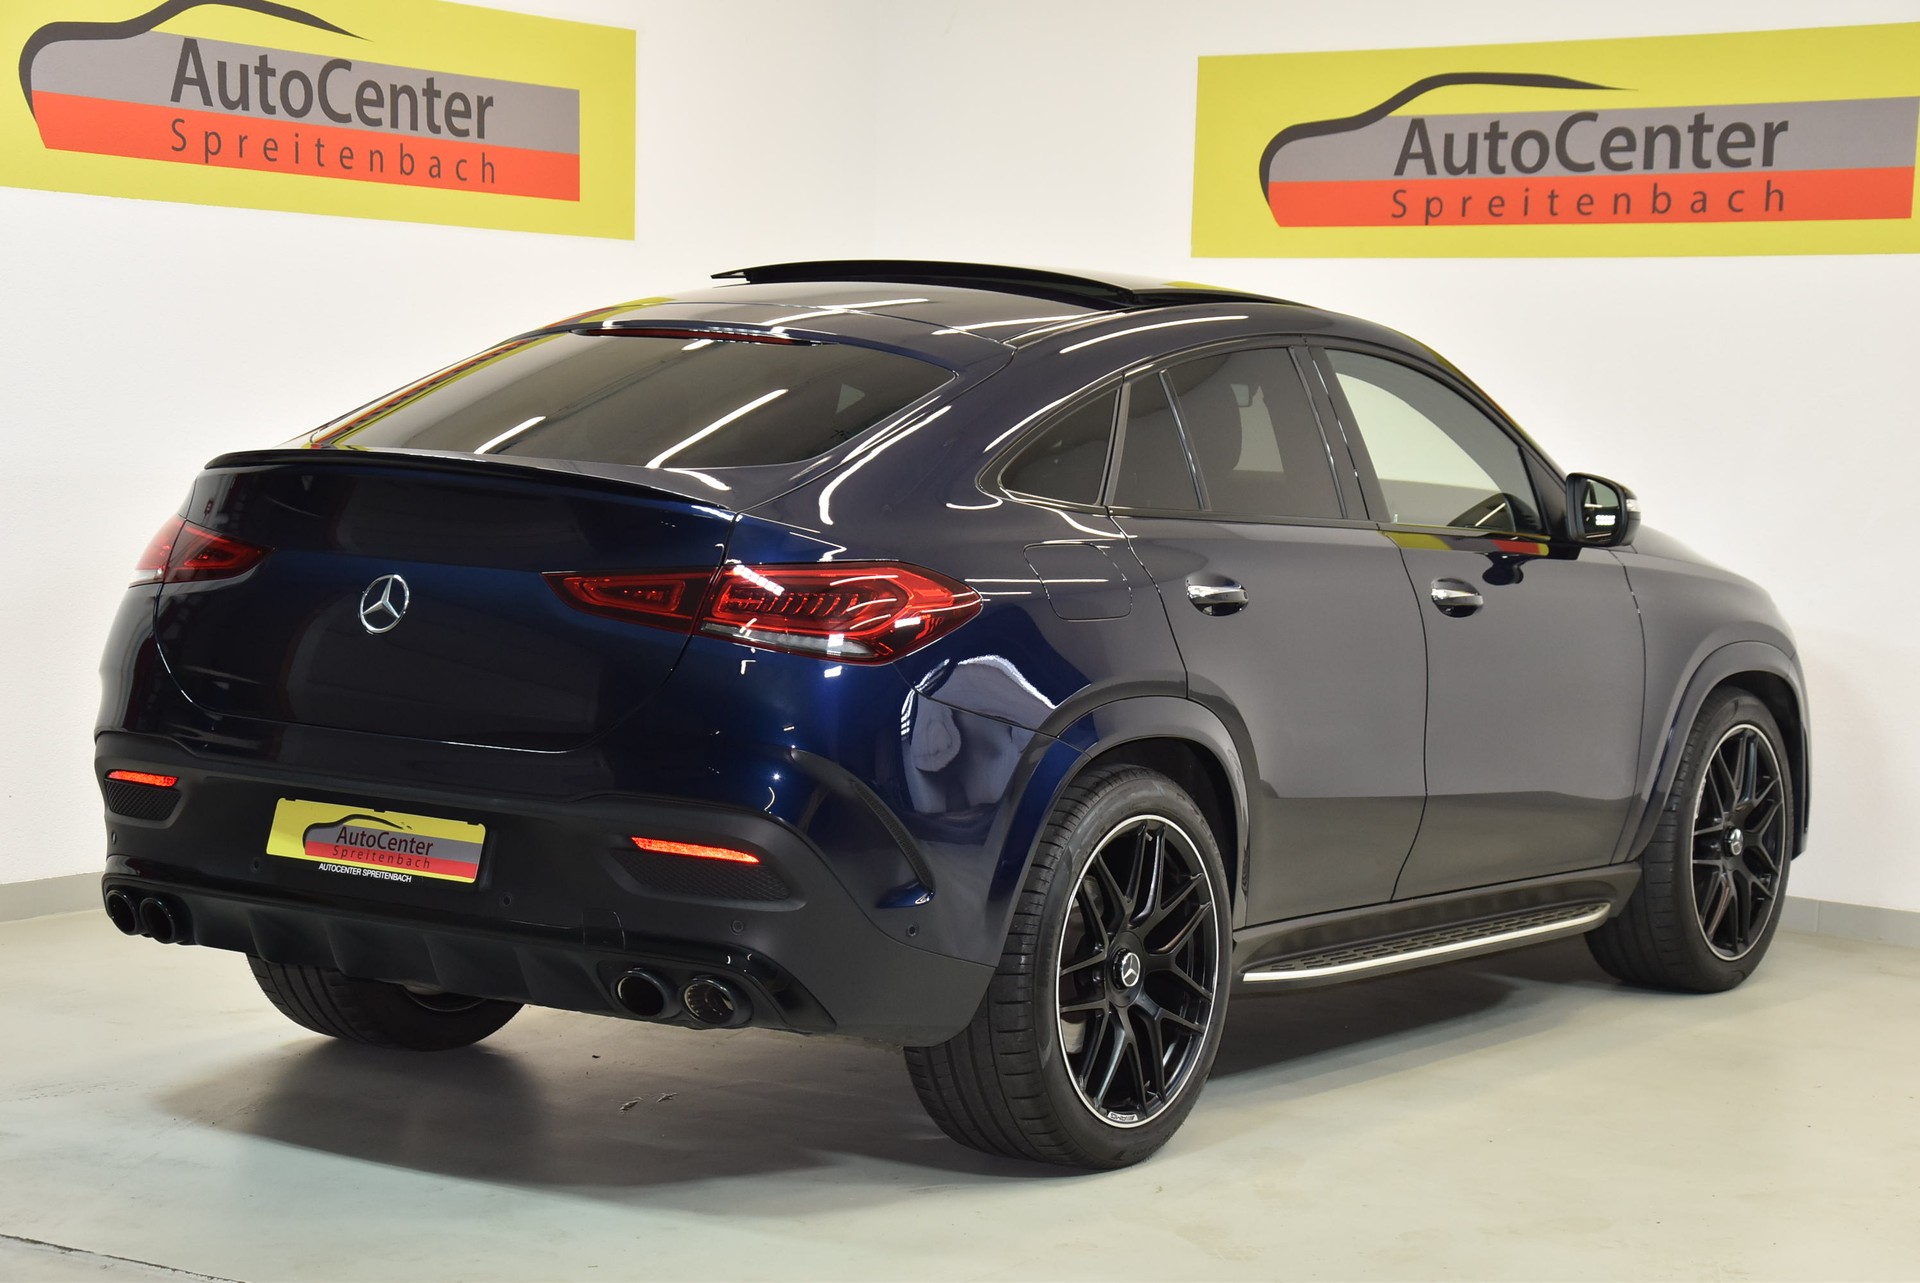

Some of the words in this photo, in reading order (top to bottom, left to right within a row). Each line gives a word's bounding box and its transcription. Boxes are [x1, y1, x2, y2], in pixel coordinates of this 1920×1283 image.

[170, 37, 494, 139] AutoCenter
[170, 118, 496, 185] Spreitenbach
[1394, 111, 1789, 177] AutoCenter
[1391, 180, 1785, 225] Spreitenbach
[332, 844, 431, 869] Spreitenbach
[336, 826, 434, 856] AutoCenter
[318, 863, 362, 876] AUTOCENTER
[362, 869, 412, 883] SPREITENBACH
